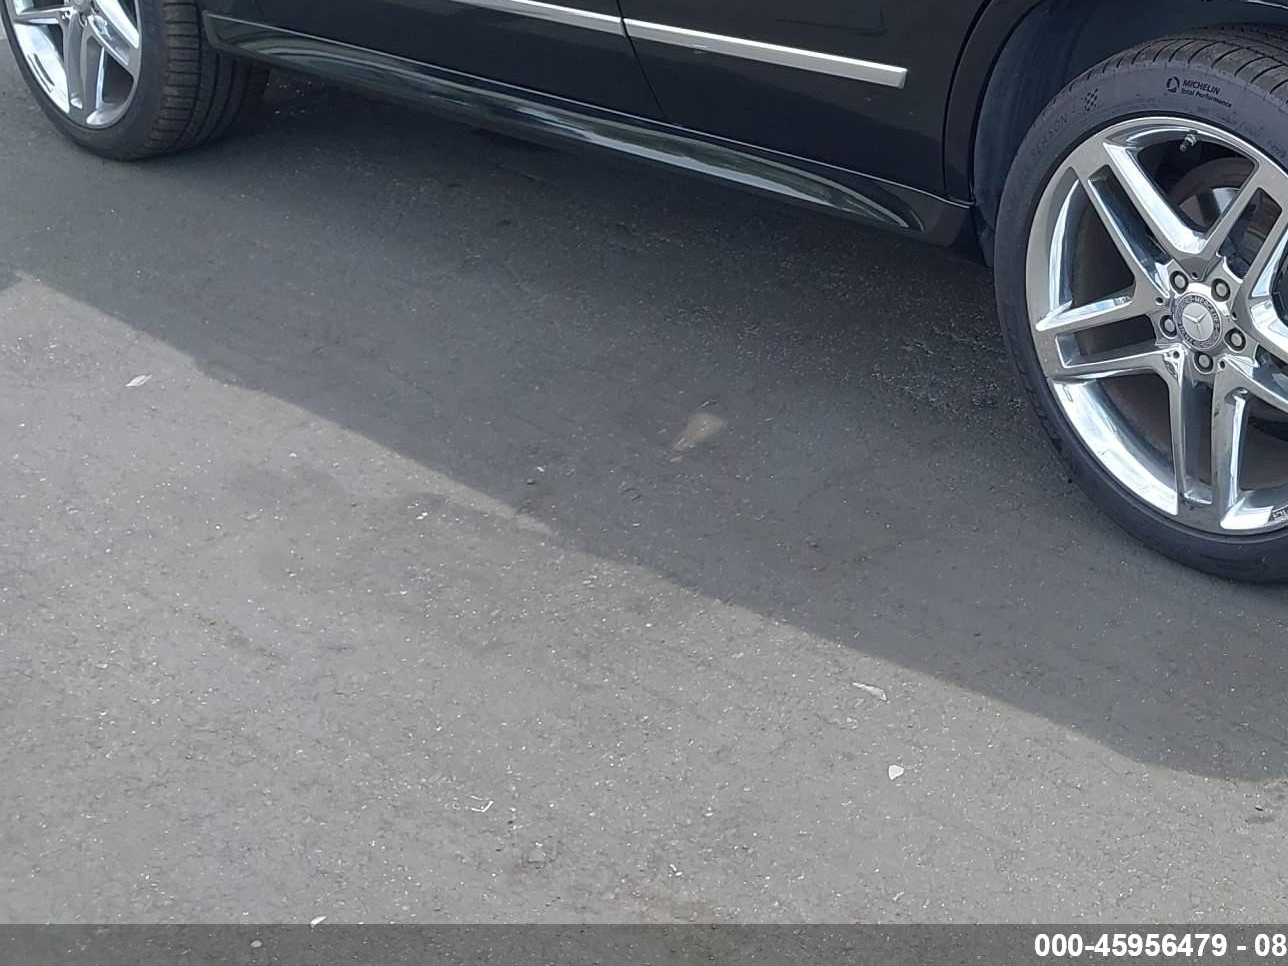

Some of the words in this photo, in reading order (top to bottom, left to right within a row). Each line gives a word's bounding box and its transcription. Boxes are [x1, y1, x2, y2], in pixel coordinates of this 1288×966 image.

[1182, 79, 1221, 95] MICHELIN
[1181, 87, 1195, 96] Total
[1195, 91, 1232, 108] Performance
